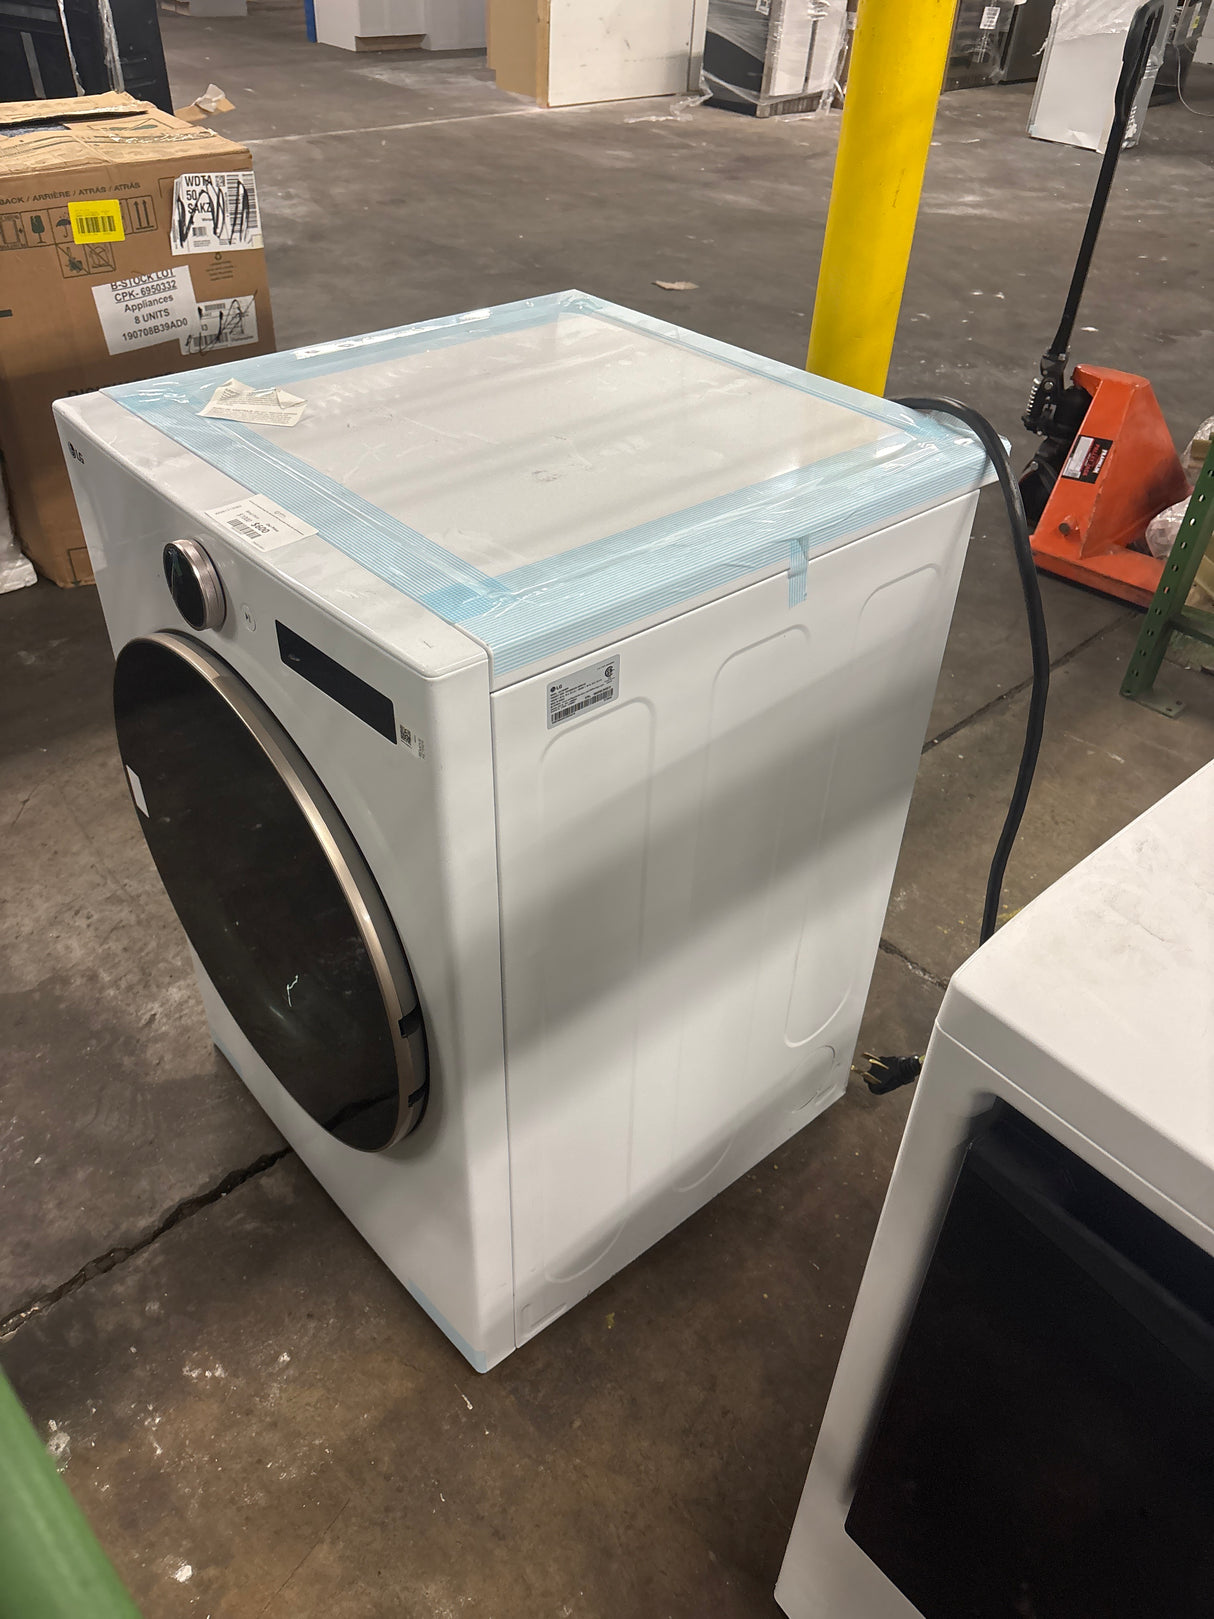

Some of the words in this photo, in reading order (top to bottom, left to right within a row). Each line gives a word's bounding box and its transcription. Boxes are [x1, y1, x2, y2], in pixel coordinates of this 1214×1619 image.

[184, 175, 212, 187] WDTA
[186, 190, 197, 201] 50
[114, 290, 140, 302] CPK-
[140, 280, 177, 297] 6950332
[124, 295, 174, 313] Appliances
[134, 315, 141, 325] 8
[142, 308, 170, 322] UNITS
[122, 317, 188, 341] 190708B39AD0
